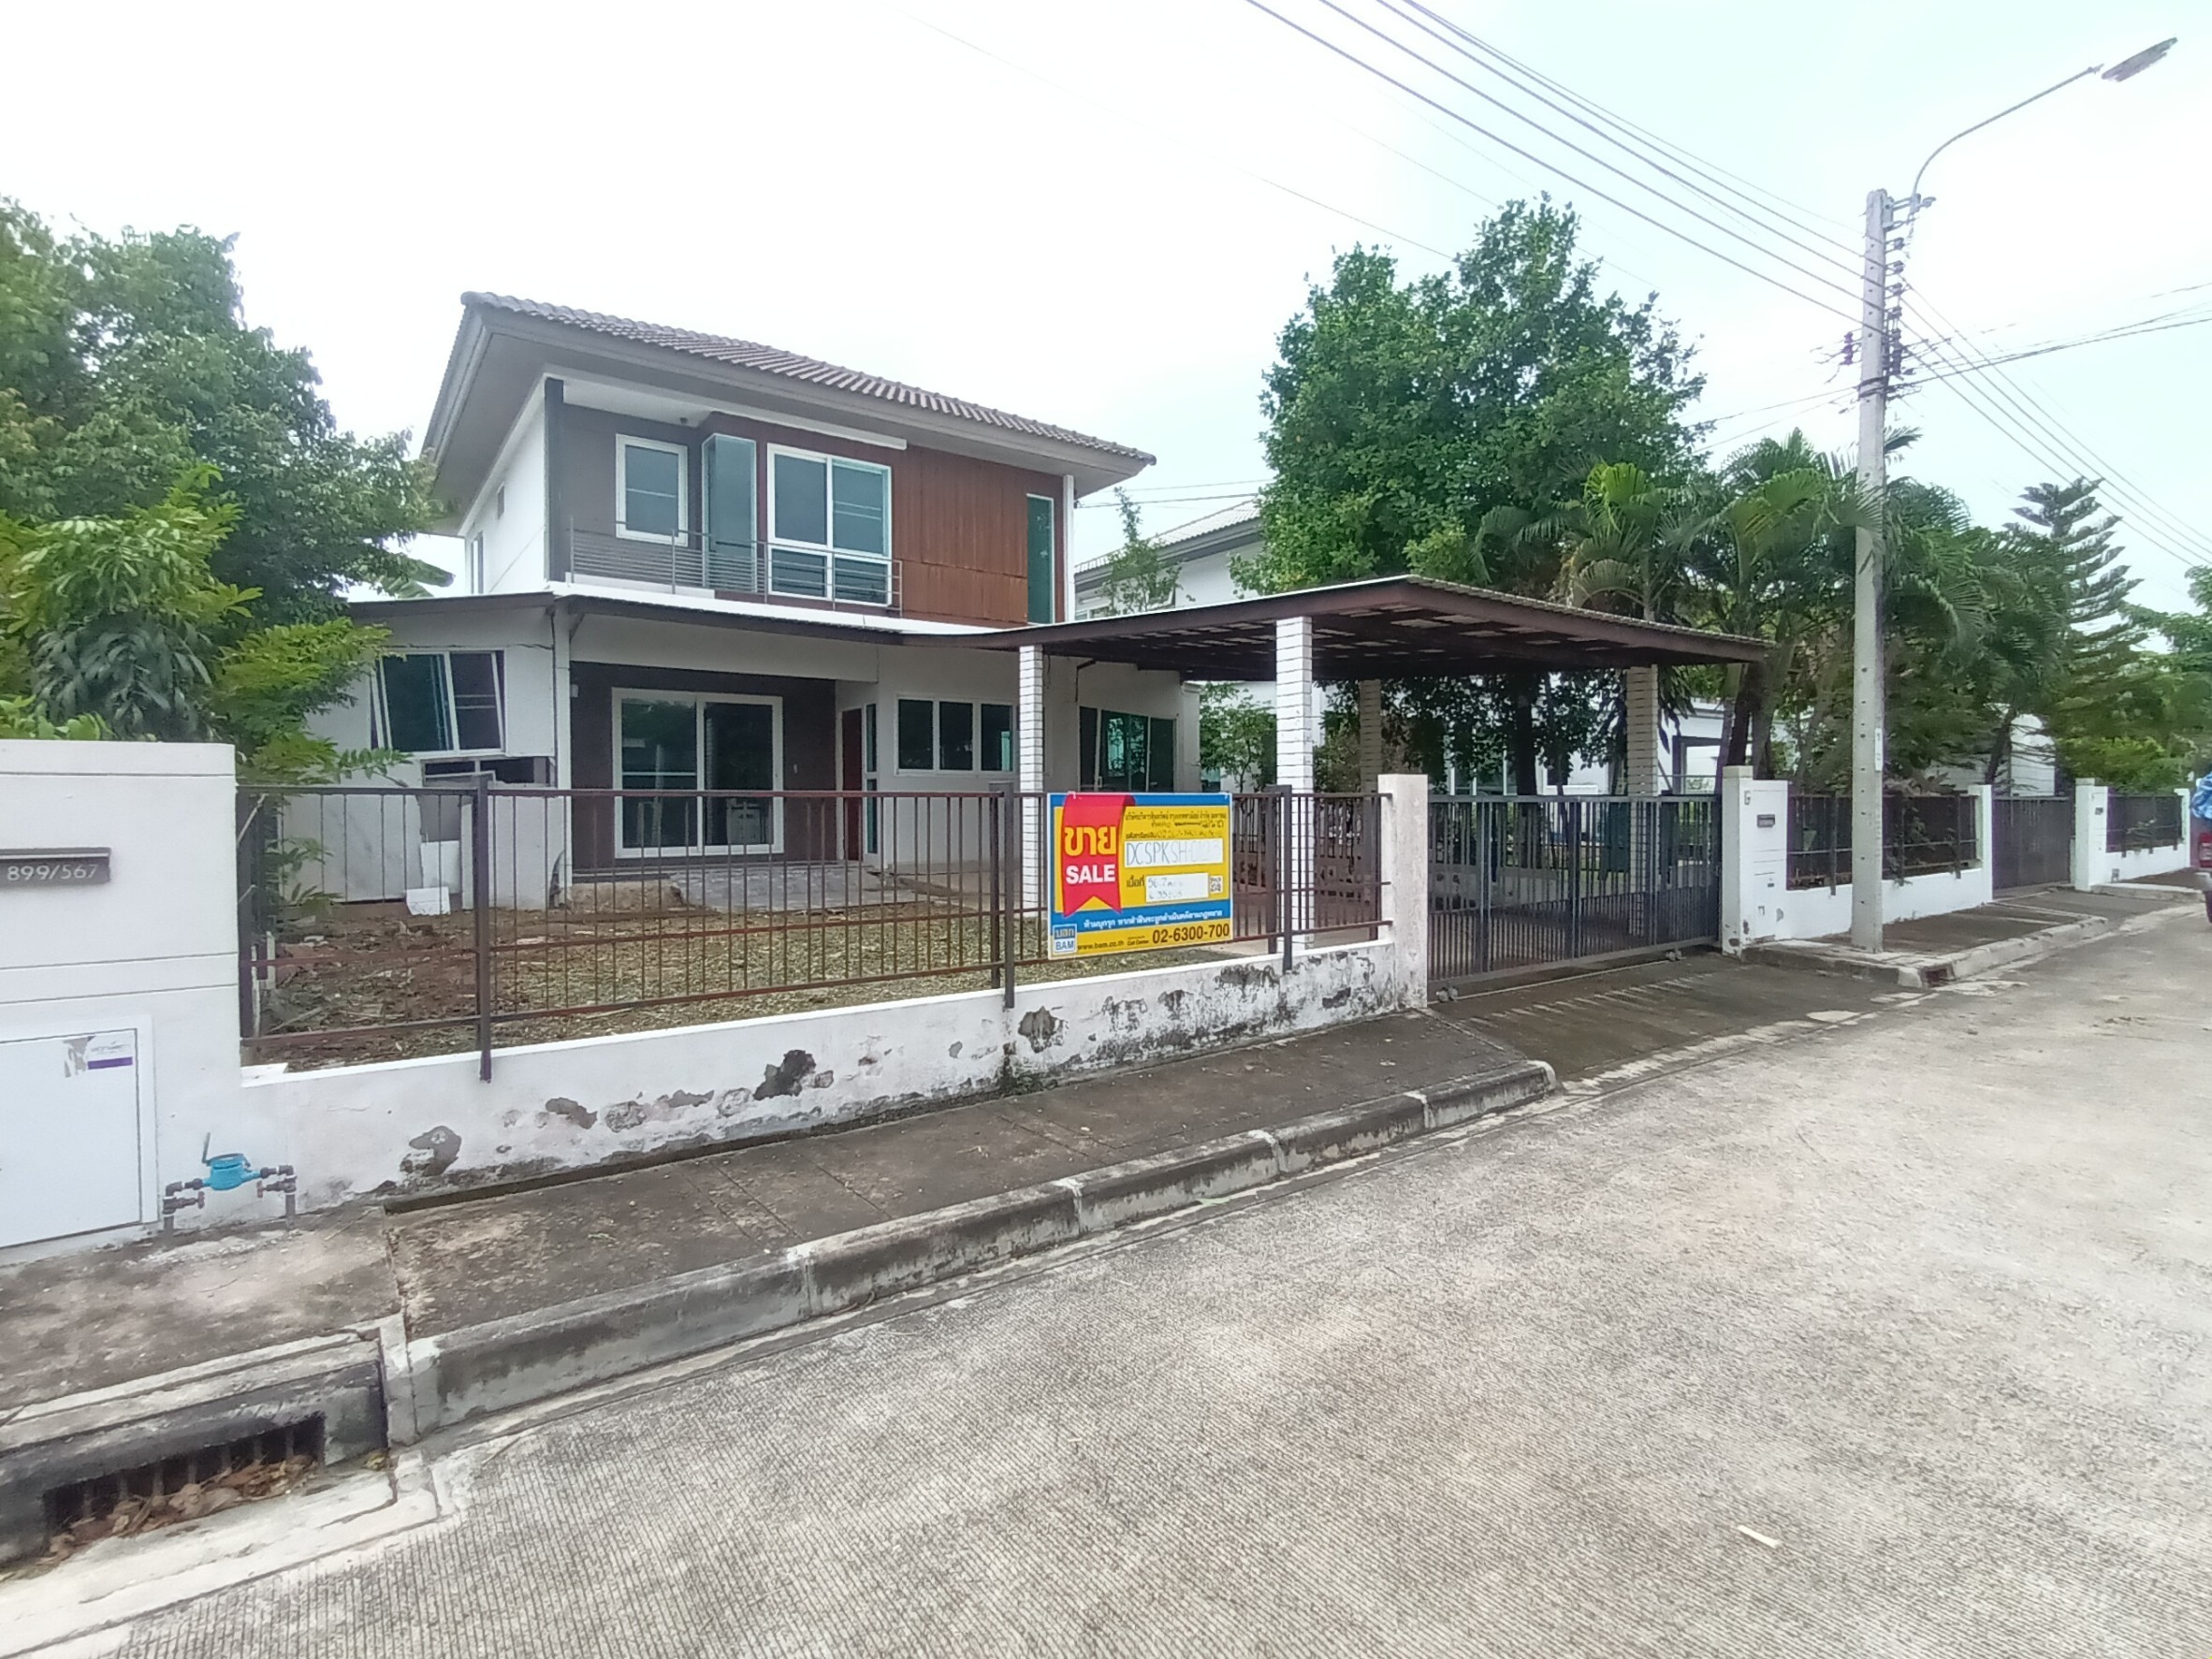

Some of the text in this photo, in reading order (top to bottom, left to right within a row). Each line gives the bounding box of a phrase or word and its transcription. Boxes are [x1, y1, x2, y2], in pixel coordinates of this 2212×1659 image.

[1065, 825, 1116, 856] ขาย
[7, 865, 98, 881] 899/567
[1066, 865, 1116, 884] SALE
[1152, 923, 1230, 944] 02-6300-700
[1055, 939, 1075, 951] BAM
